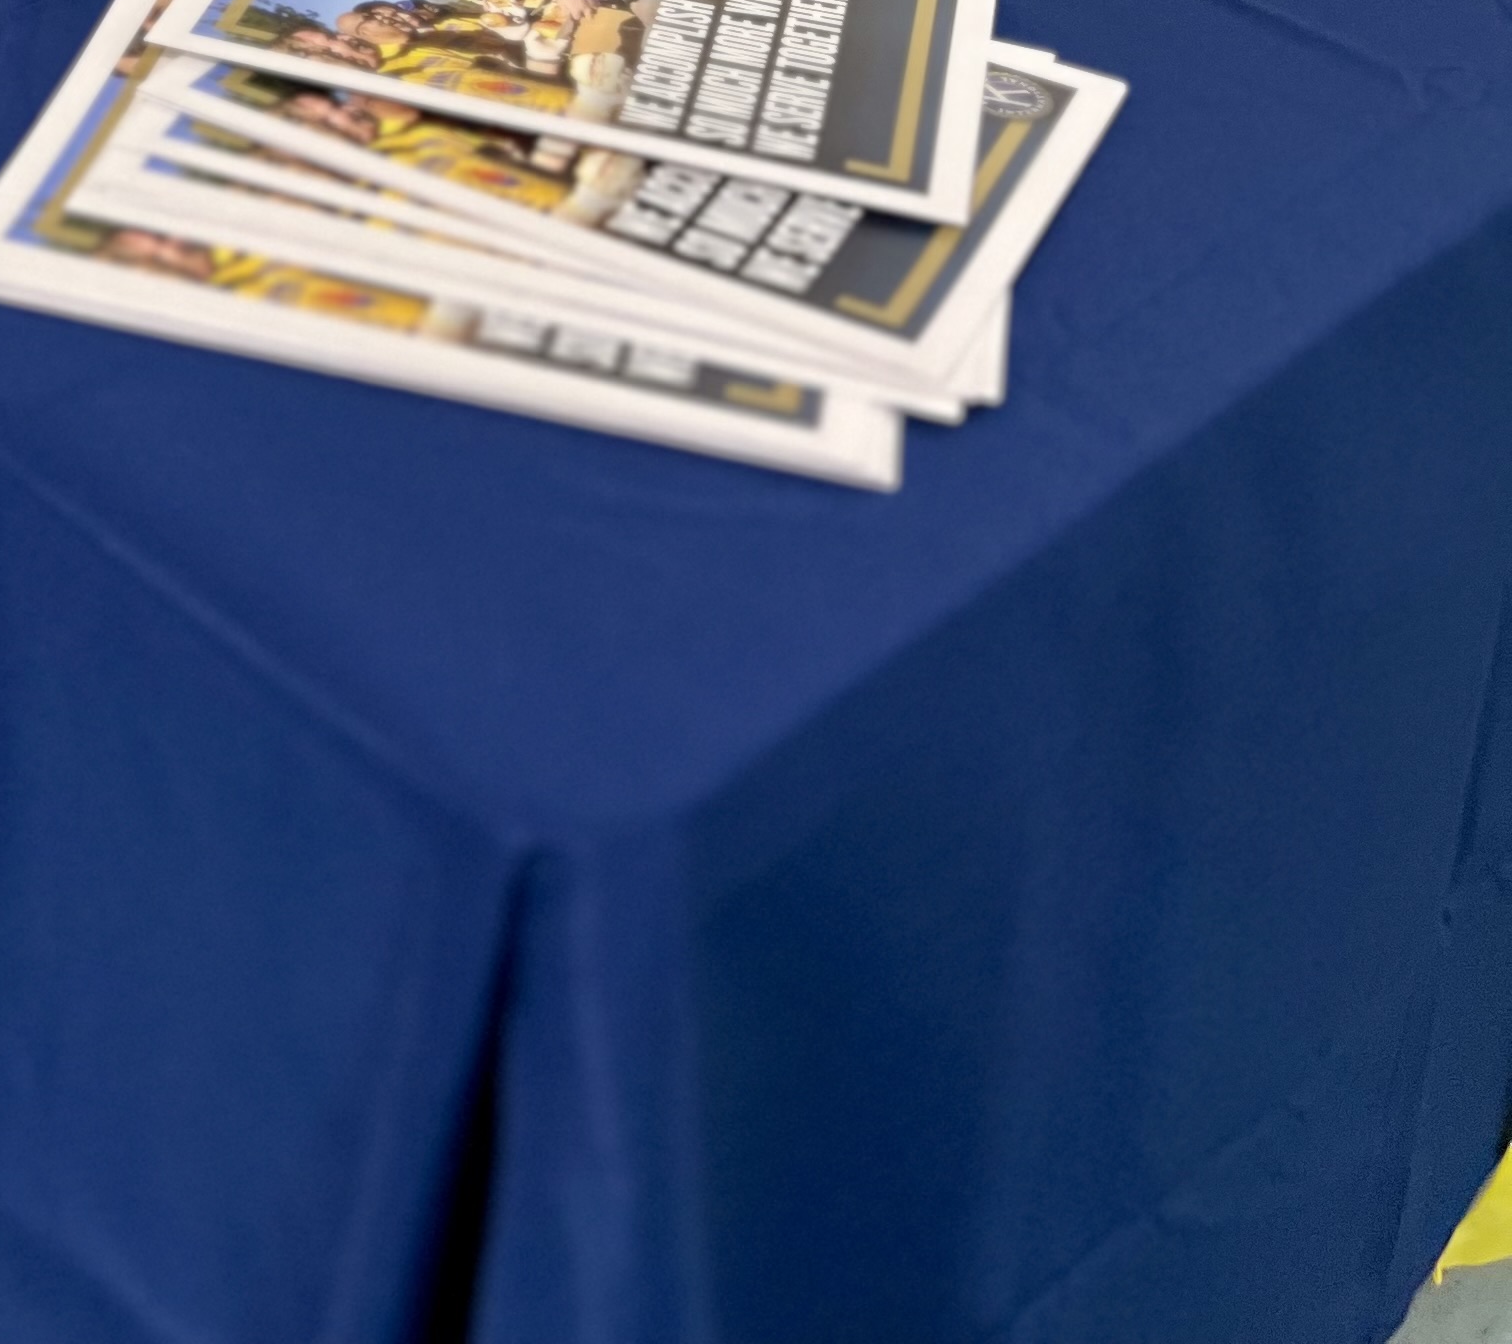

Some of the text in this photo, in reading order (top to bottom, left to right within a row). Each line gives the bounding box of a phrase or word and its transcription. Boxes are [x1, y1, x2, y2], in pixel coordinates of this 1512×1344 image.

[709, 14, 777, 69] MORE
[618, 95, 687, 132] WE
[693, 63, 765, 122] MUCH
[762, 69, 832, 131] SERVE
[685, 113, 750, 148] SO
[752, 124, 819, 161] WE
